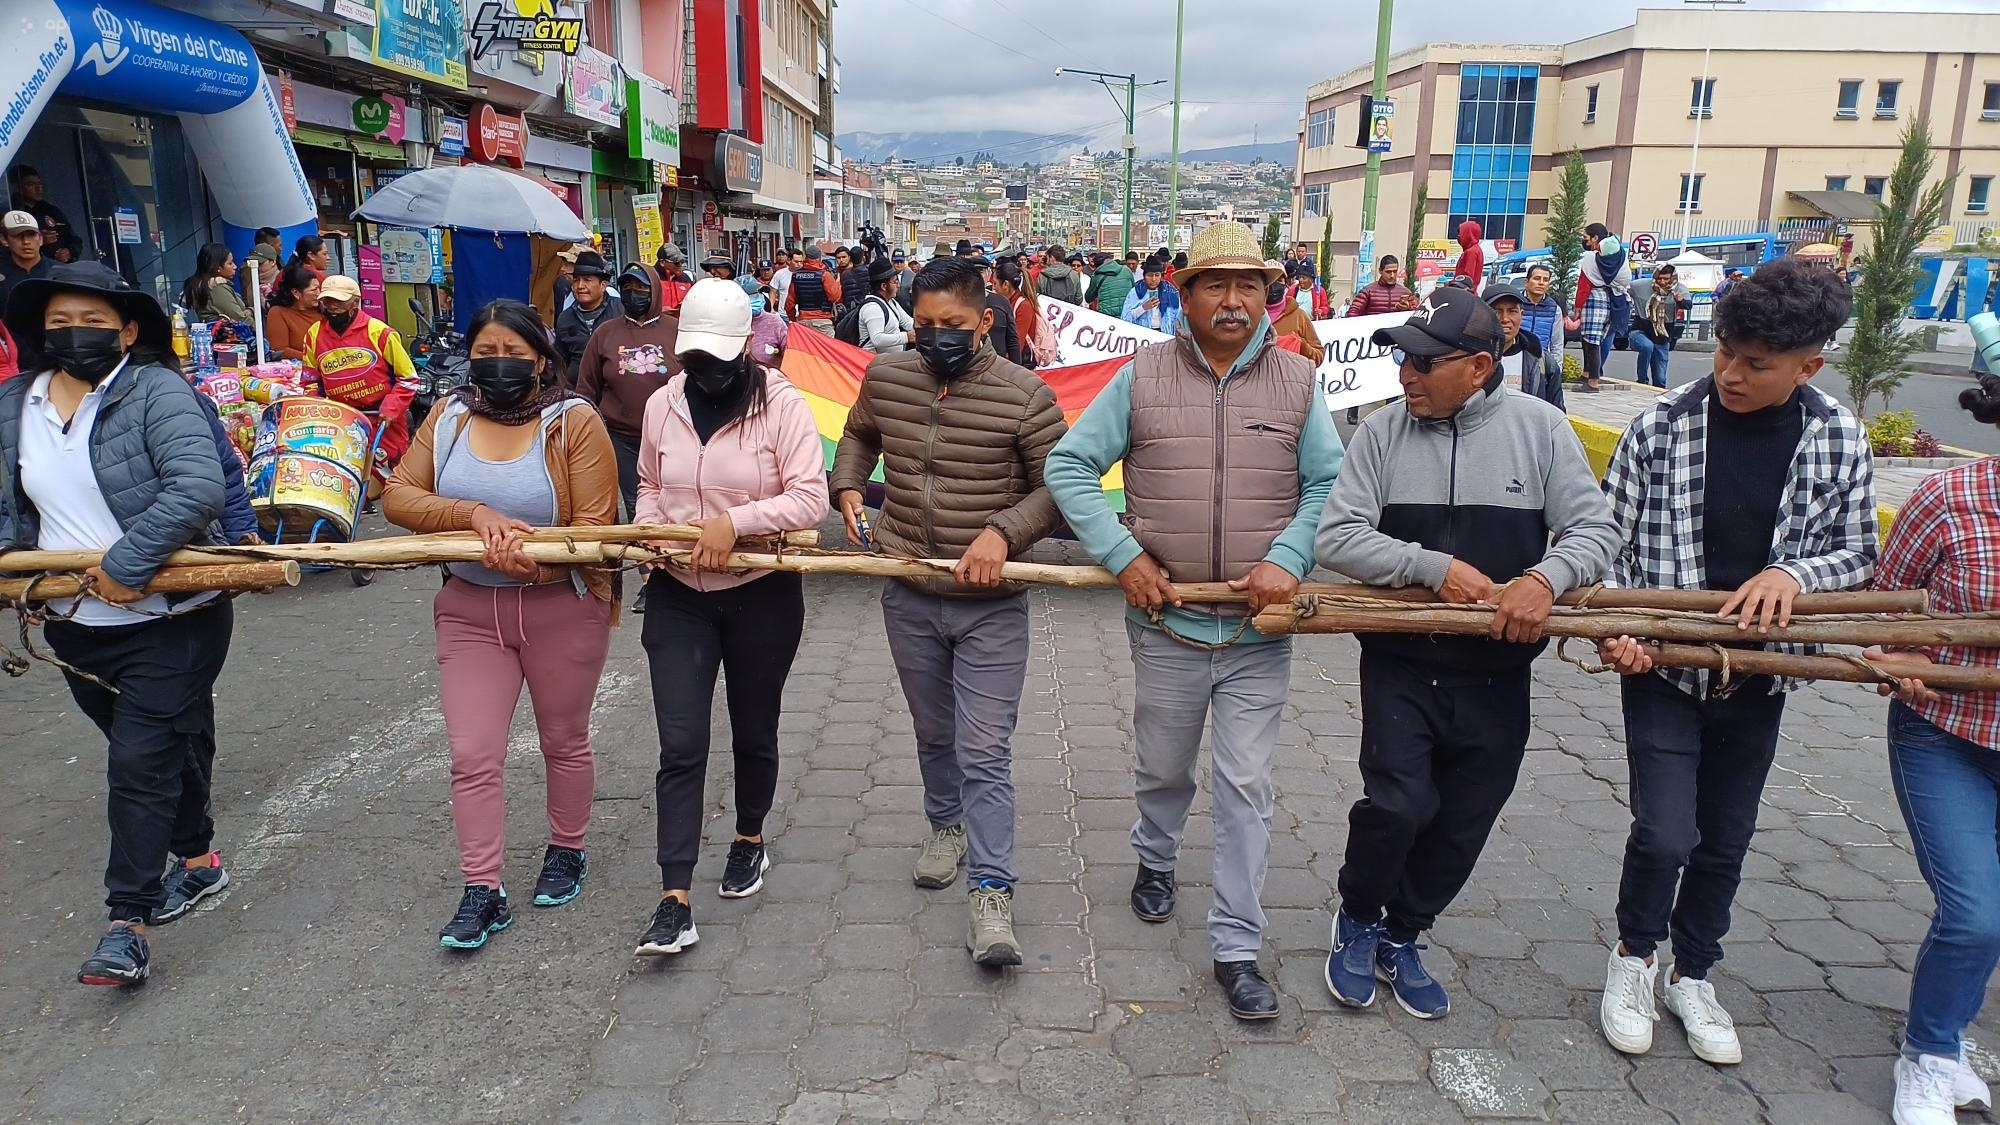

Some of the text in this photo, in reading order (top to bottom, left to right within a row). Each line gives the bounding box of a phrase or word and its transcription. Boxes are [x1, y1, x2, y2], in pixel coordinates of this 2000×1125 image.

[125, 17, 248, 67] Virgen del Cisne
[132, 54, 179, 72] COOPERATIVA
[180, 64, 190, 75] DE
[191, 66, 217, 80] AHORRO
[223, 71, 248, 86] CRÉDITO
[0, 36, 68, 147] gendelcisne.fin.ec
[1372, 104, 1393, 113] OTTO
[482, 122, 498, 140] Claro
[214, 381, 239, 394] Fab
[286, 406, 341, 418] NUEVO
